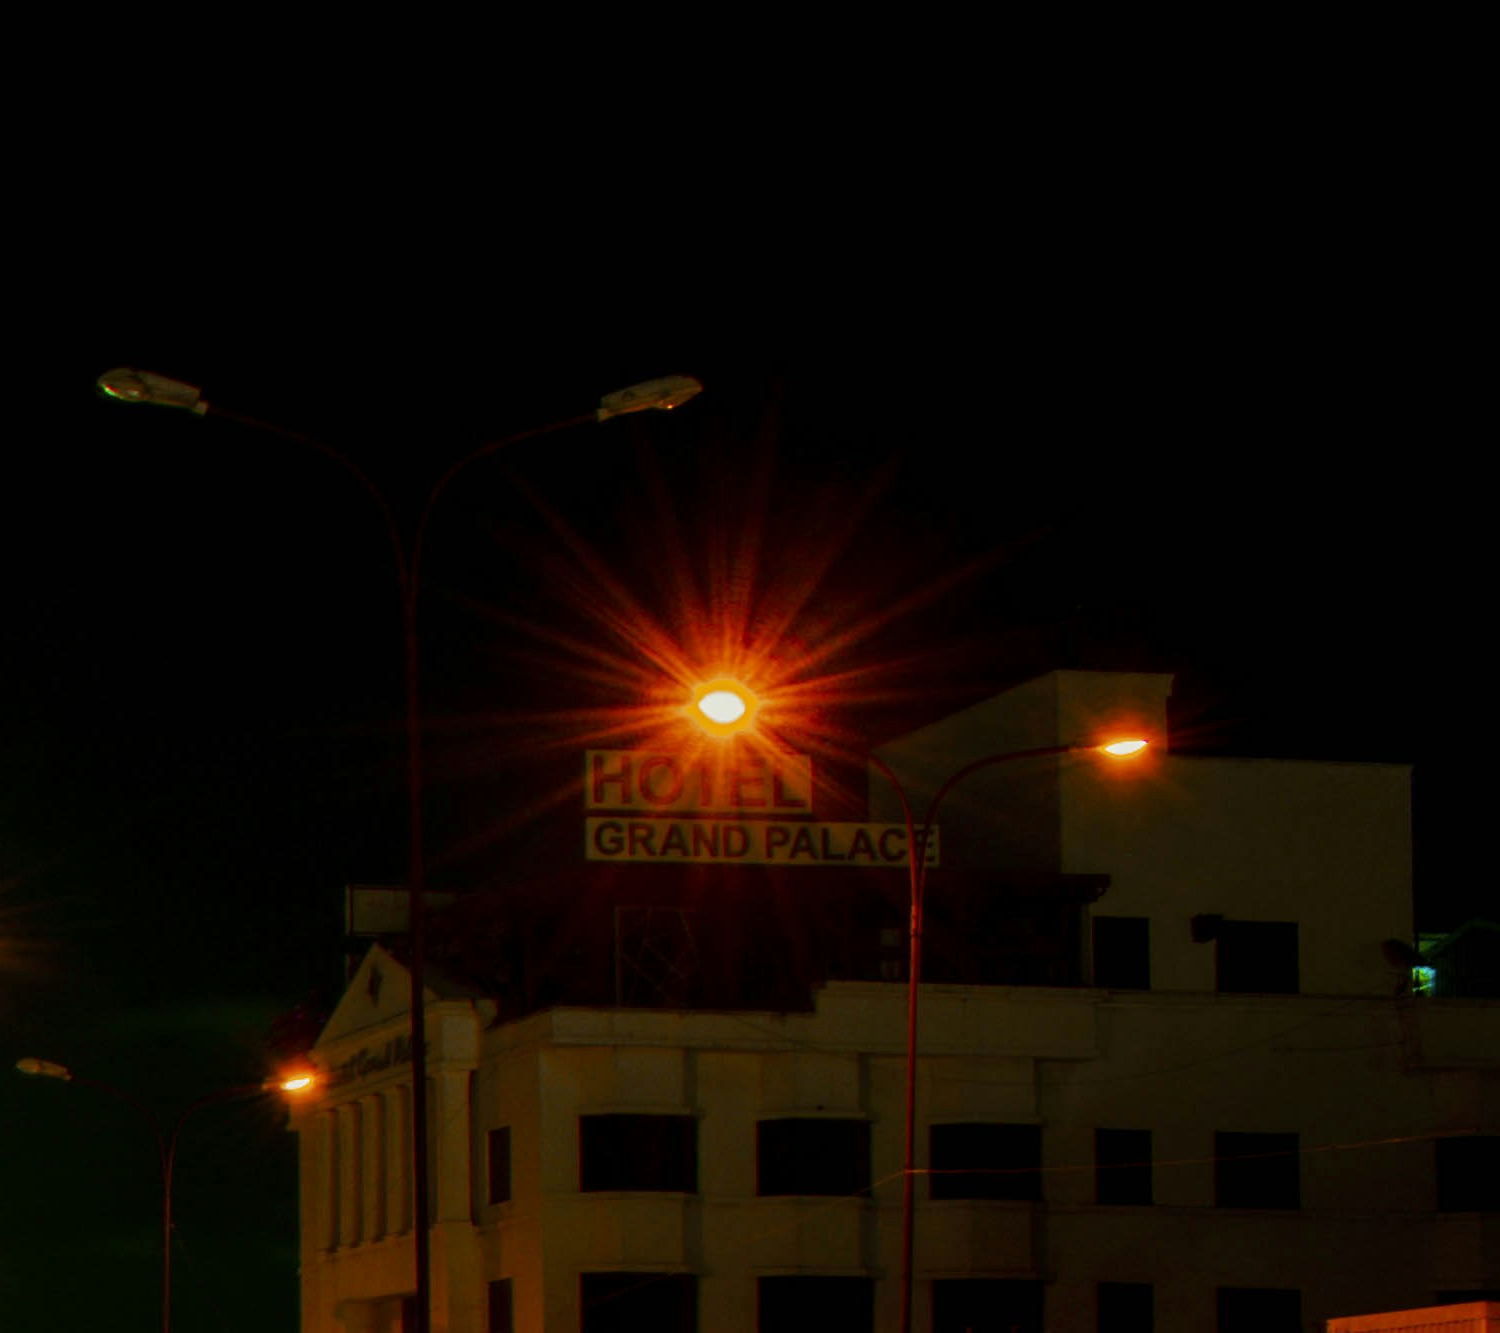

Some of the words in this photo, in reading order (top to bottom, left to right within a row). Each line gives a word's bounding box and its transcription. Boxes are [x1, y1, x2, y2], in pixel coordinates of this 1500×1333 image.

[590, 755, 805, 810] HOTEL
[593, 821, 751, 859] GRAND
[764, 825, 936, 864] PALACE
